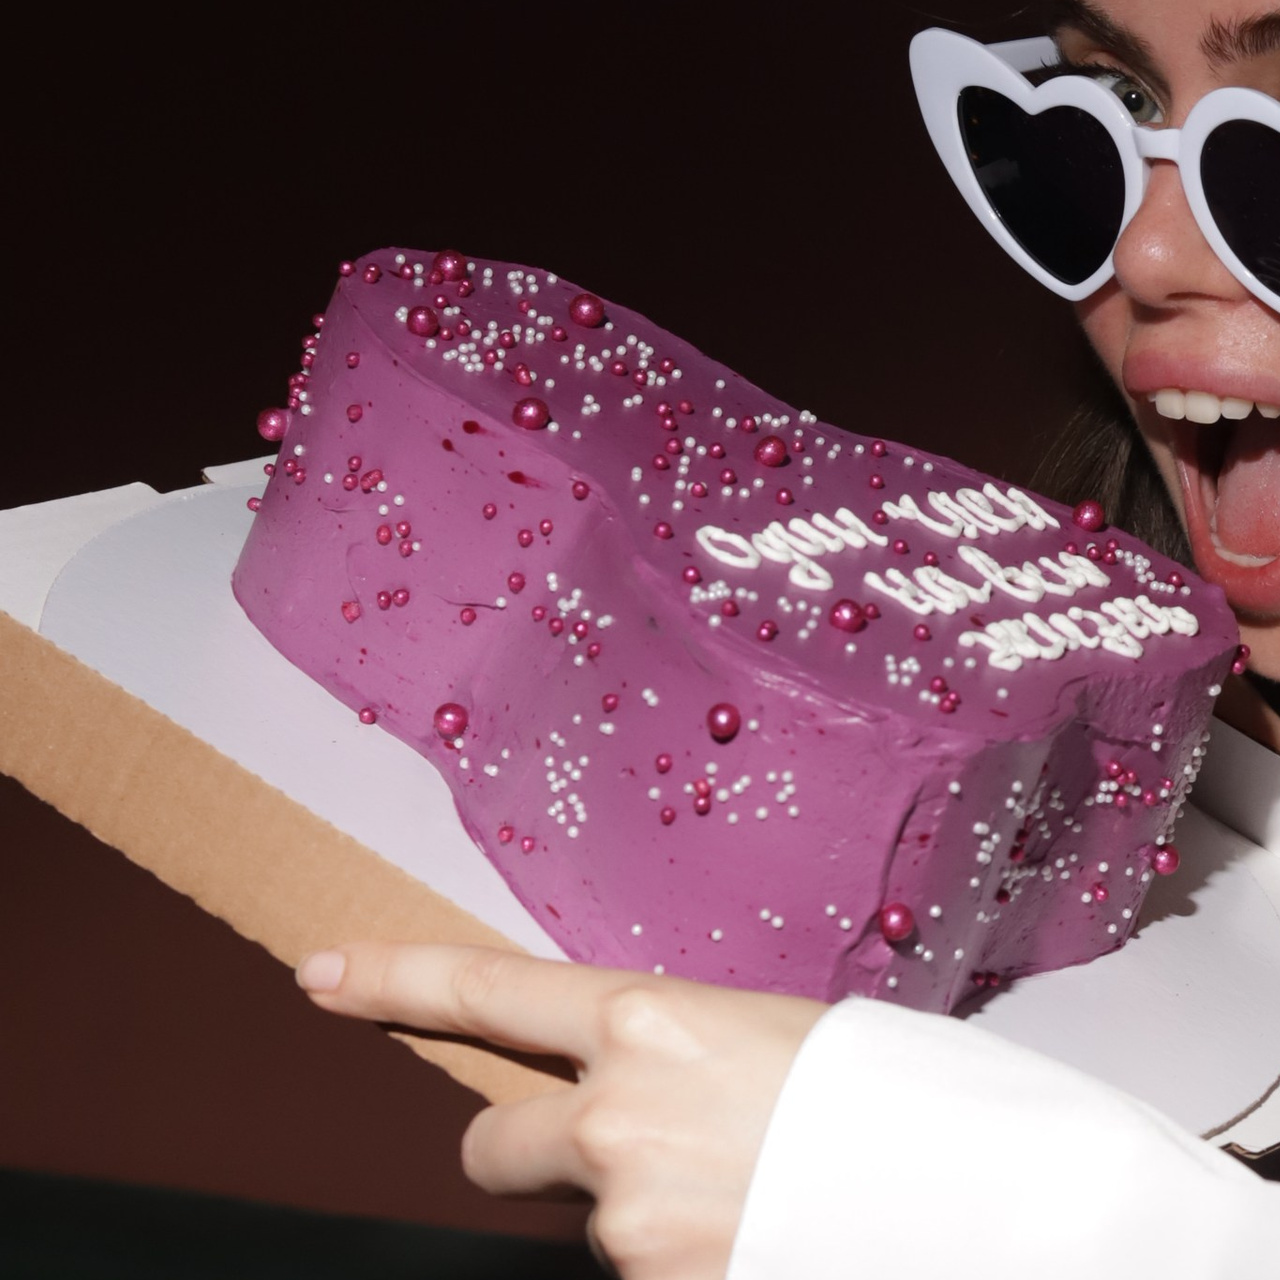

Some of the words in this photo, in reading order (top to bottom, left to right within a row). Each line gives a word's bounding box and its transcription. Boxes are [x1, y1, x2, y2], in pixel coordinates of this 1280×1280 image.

[695, 506, 889, 591] Один
[881, 482, 1061, 540] член
[863, 565, 993, 616] на
[957, 544, 1112, 604] всю
[957, 594, 1200, 672] жизнь
